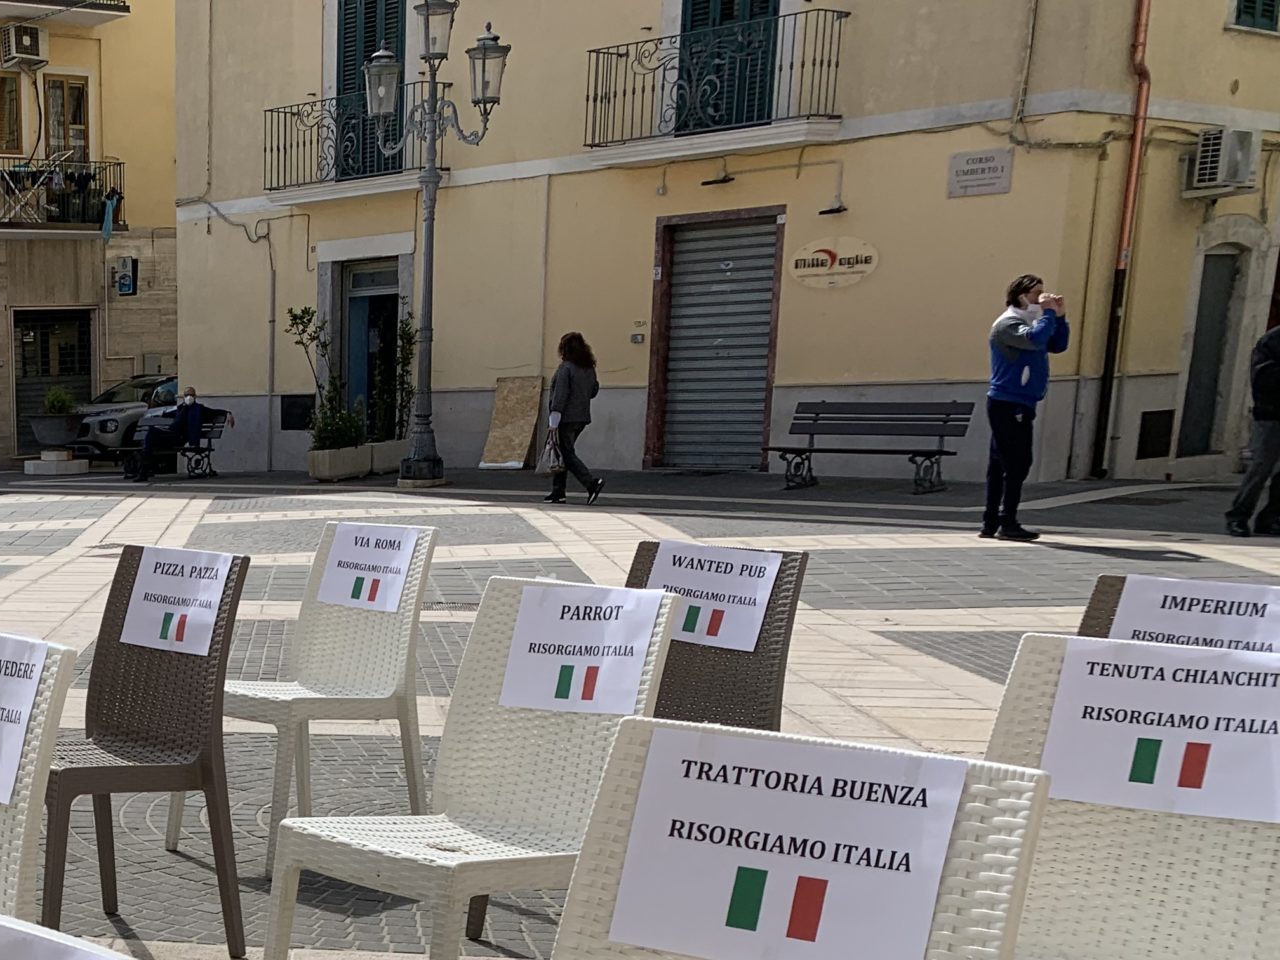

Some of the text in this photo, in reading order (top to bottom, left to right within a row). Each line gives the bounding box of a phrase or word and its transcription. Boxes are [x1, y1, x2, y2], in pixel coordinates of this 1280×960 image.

[966, 156, 995, 165] CORSO
[955, 166, 999, 177] UMBERTO
[354, 536, 401, 551] VIA ROMA
[153, 561, 219, 580] PIZZA PAZZA
[337, 560, 382, 574] RISORGIAMO
[671, 554, 767, 579] WANTED PUB
[143, 592, 191, 608] RISORGIAMO
[726, 595, 757, 607] ITALIA
[1160, 594, 1268, 618] IMPERIUM
[560, 605, 624, 621] PARROT
[528, 642, 635, 657] RISORGIAMO ITALIA
[1130, 629, 1274, 653] RISORGIAMO ITALIA
[1086, 661, 1280, 688] TENUTA CHIANCHIT
[1081, 705, 1280, 735] RISORGIAMO ITALIA
[680, 759, 929, 808] TRATTORIA BUENZA
[667, 818, 912, 873] RISORGIAMO ITALIA
